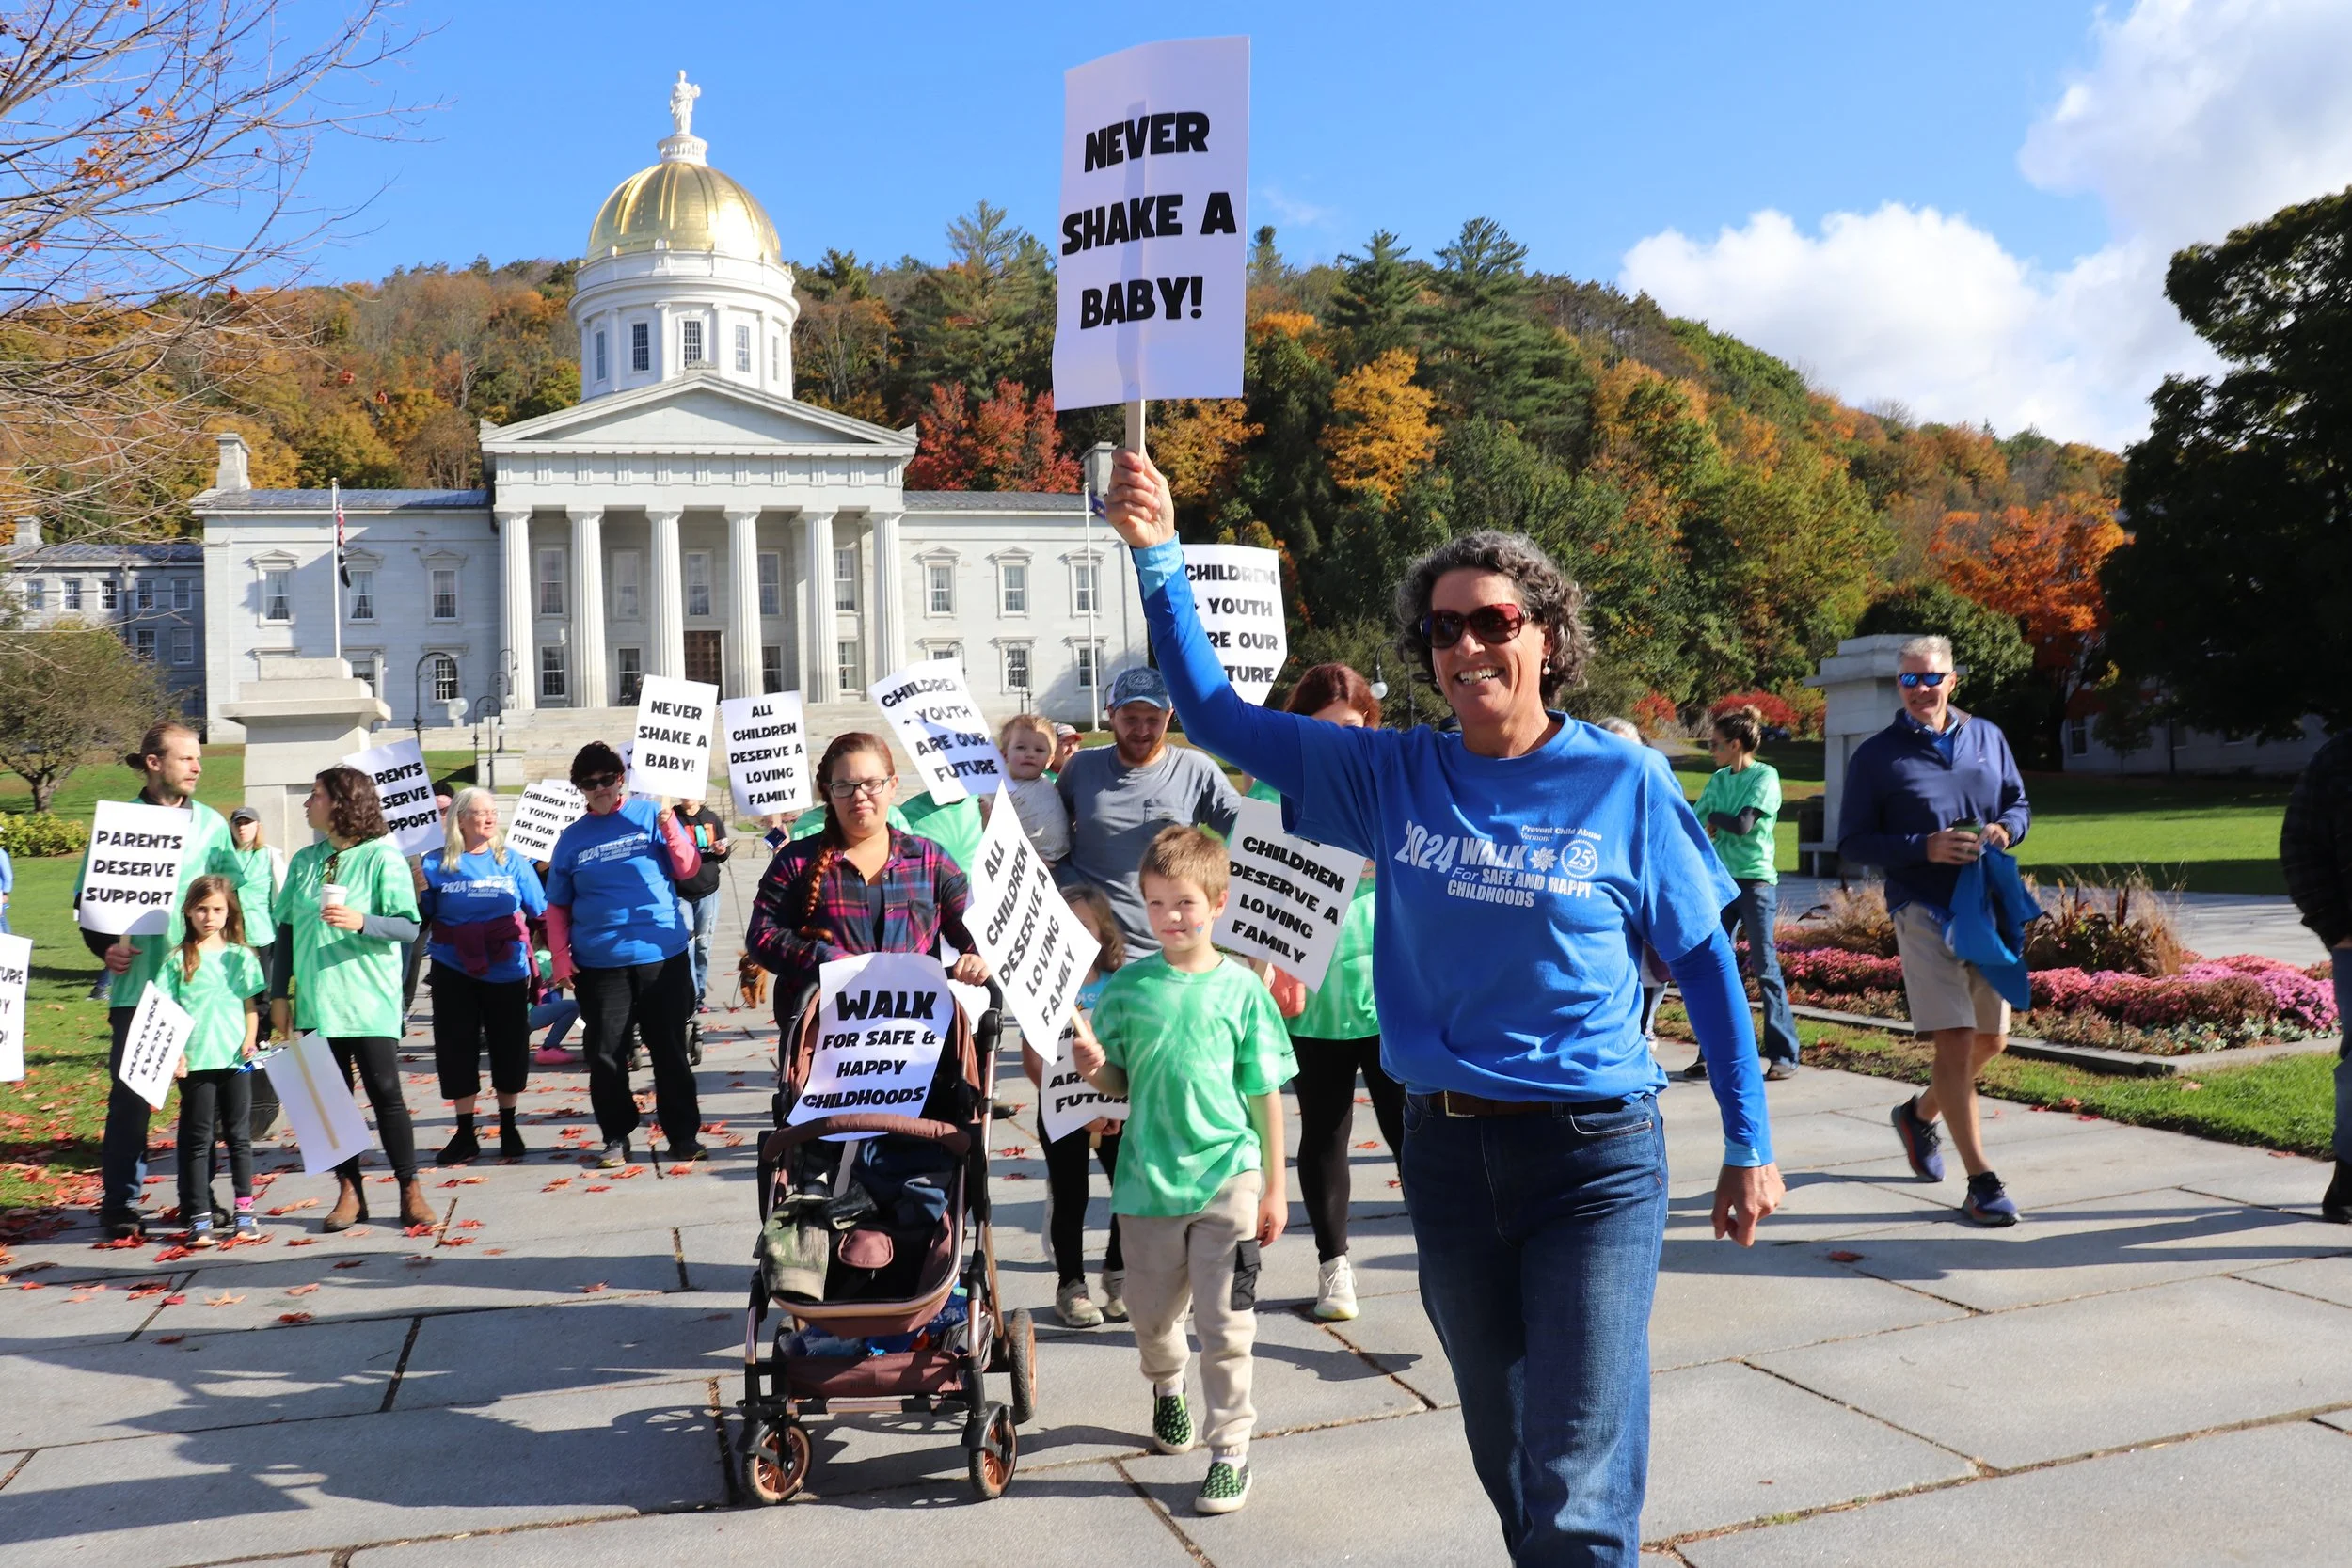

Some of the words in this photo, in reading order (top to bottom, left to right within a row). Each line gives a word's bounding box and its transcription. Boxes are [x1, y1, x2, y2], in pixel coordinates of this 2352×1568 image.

[1084, 111, 1210, 173] NEVER
[1061, 194, 1184, 256] SHAKE
[1200, 192, 1237, 235] A
[1080, 276, 1204, 330] BABY!
[1185, 564, 1277, 585] CHILDREN
[1208, 598, 1273, 616] YOUTH
[1207, 632, 1232, 648] RE
[1238, 632, 1278, 650] OUR
[1223, 665, 1275, 683] TURE
[882, 678, 962, 707] CHILDRE
[650, 700, 702, 721] NEVER
[751, 705, 773, 718] ALL
[916, 705, 972, 723] YOUTH
[638, 725, 691, 745] SHAKE
[696, 735, 707, 748] A
[732, 722, 797, 742] CHILDREN
[730, 745, 789, 764] DESERVE
[795, 743, 803, 754] A
[915, 733, 953, 756] ARE
[955, 732, 990, 748] OUR
[645, 753, 695, 772] BABY!
[934, 759, 998, 782] FUTURE
[374, 762, 423, 785] RENTS
[746, 767, 794, 784] LOVING
[381, 786, 430, 809] SERVE
[524, 790, 566, 808] CHILDREN
[749, 788, 796, 806] FAMILY
[388, 809, 437, 832] PPORT
[530, 807, 559, 821] YOUTH
[515, 819, 533, 830] ARE
[535, 825, 555, 836] OUR
[1520, 832, 1550, 842] Vermont
[1521, 824, 1553, 834] Prevent
[1554, 827, 1576, 835] Child
[1577, 828, 1602, 841] Abuse
[96, 830, 183, 849] PARENTS
[512, 833, 548, 850] FUTURE
[1394, 820, 1459, 873] 2024
[1459, 837, 1529, 870] WALK
[93, 859, 176, 878] DESERVE
[984, 839, 1005, 883] ALL
[1242, 836, 1346, 893] CHILDREN
[987, 839, 1028, 946] CHILDREN
[1230, 861, 1320, 912] DESERVE
[1323, 906, 1339, 925] A
[1452, 867, 1479, 882] For
[1482, 868, 1512, 887] SAFE
[1515, 872, 1545, 890] AND
[1548, 877, 1593, 898] HAPPY
[85, 887, 173, 905] SUPPORT
[1447, 879, 1534, 908] CHILDHOODS
[998, 885, 1043, 987] DESERVE
[1036, 867, 1048, 885] A
[1239, 894, 1313, 939] LOVING
[1232, 919, 1307, 964] FAMILY
[1026, 914, 1060, 997] LOVING
[1041, 942, 1075, 1027] FAMILY
[836, 990, 937, 1021] WALK
[822, 1031, 860, 1050] FOR
[865, 1030, 916, 1046] SAFE
[921, 1030, 937, 1045] &
[836, 1060, 908, 1078] HAPPY
[1048, 1072, 1085, 1088] AR
[802, 1086, 927, 1109] CHILDHOODS
[1056, 1093, 1129, 1113] FUTUR
